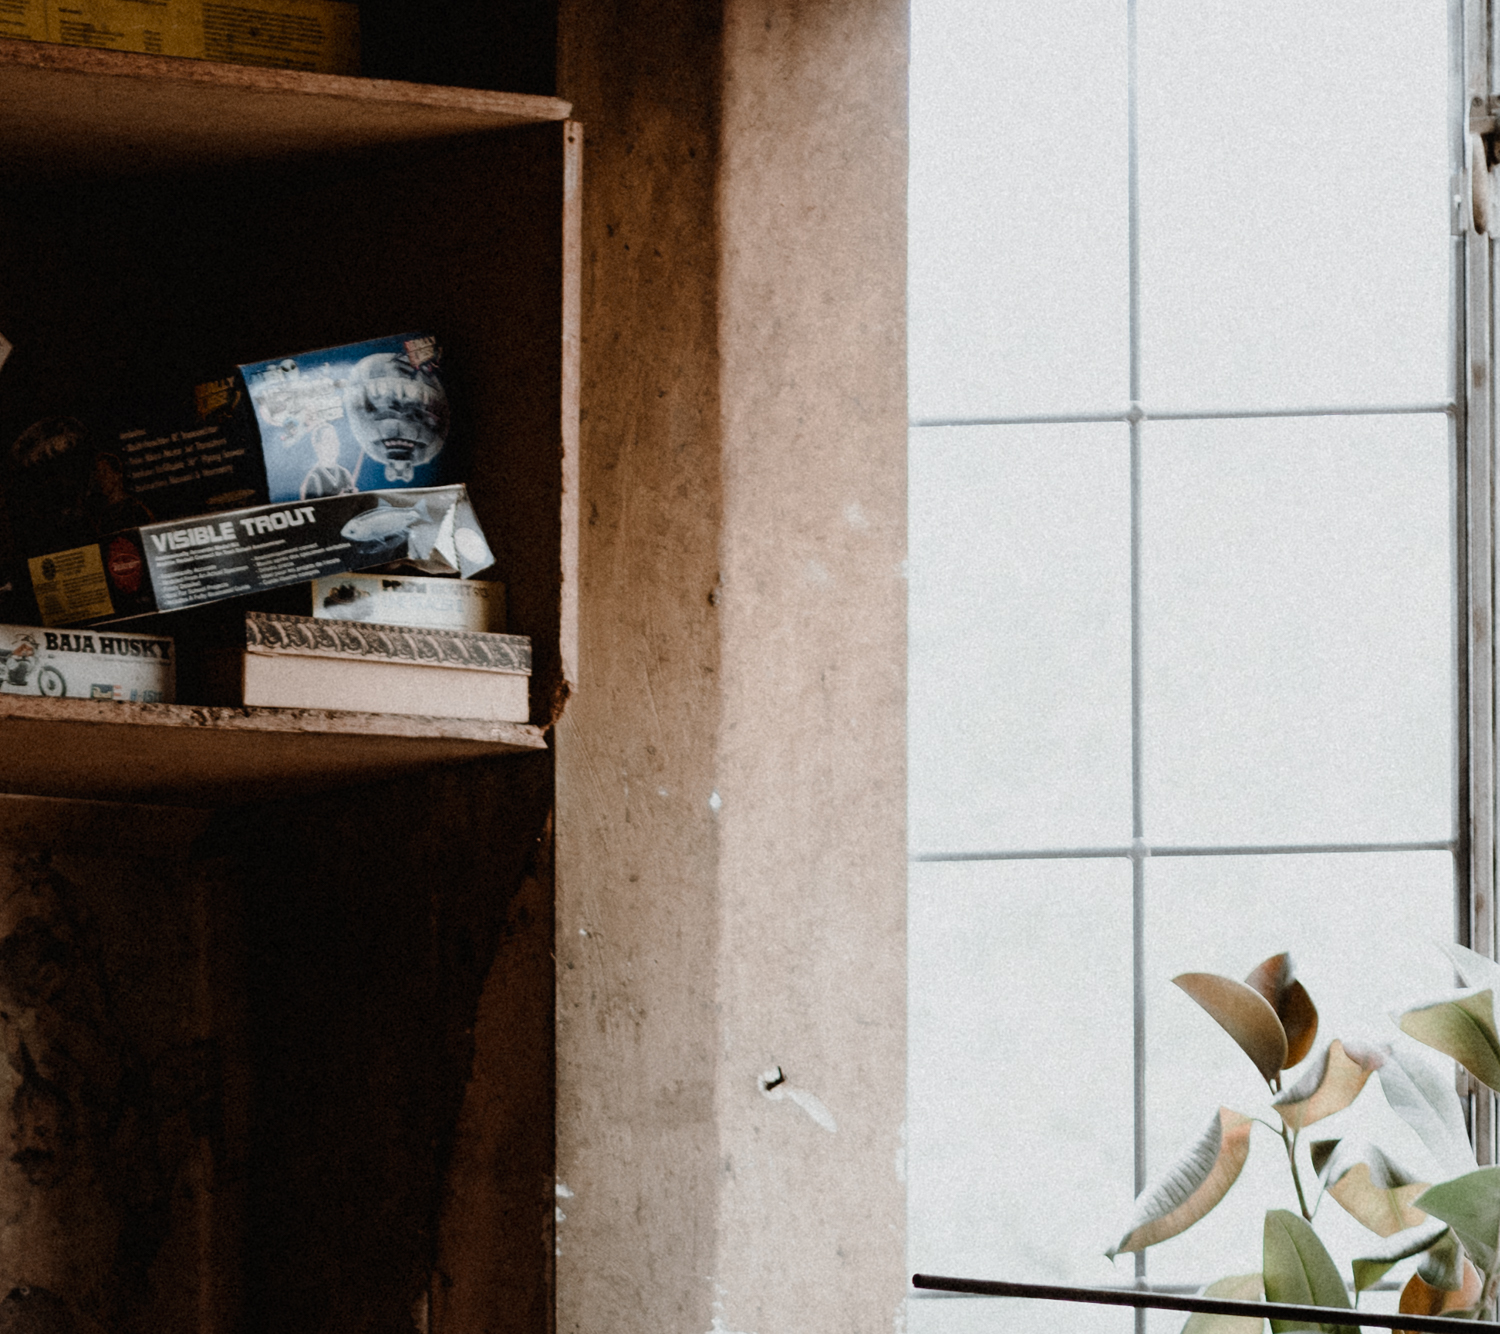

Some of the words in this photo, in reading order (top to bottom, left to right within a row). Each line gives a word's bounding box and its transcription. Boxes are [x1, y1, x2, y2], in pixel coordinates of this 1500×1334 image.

[150, 521, 238, 552] VISIBLE
[240, 506, 317, 538] TROUT
[44, 632, 96, 654] BAJA
[98, 636, 172, 660] HUSKY
